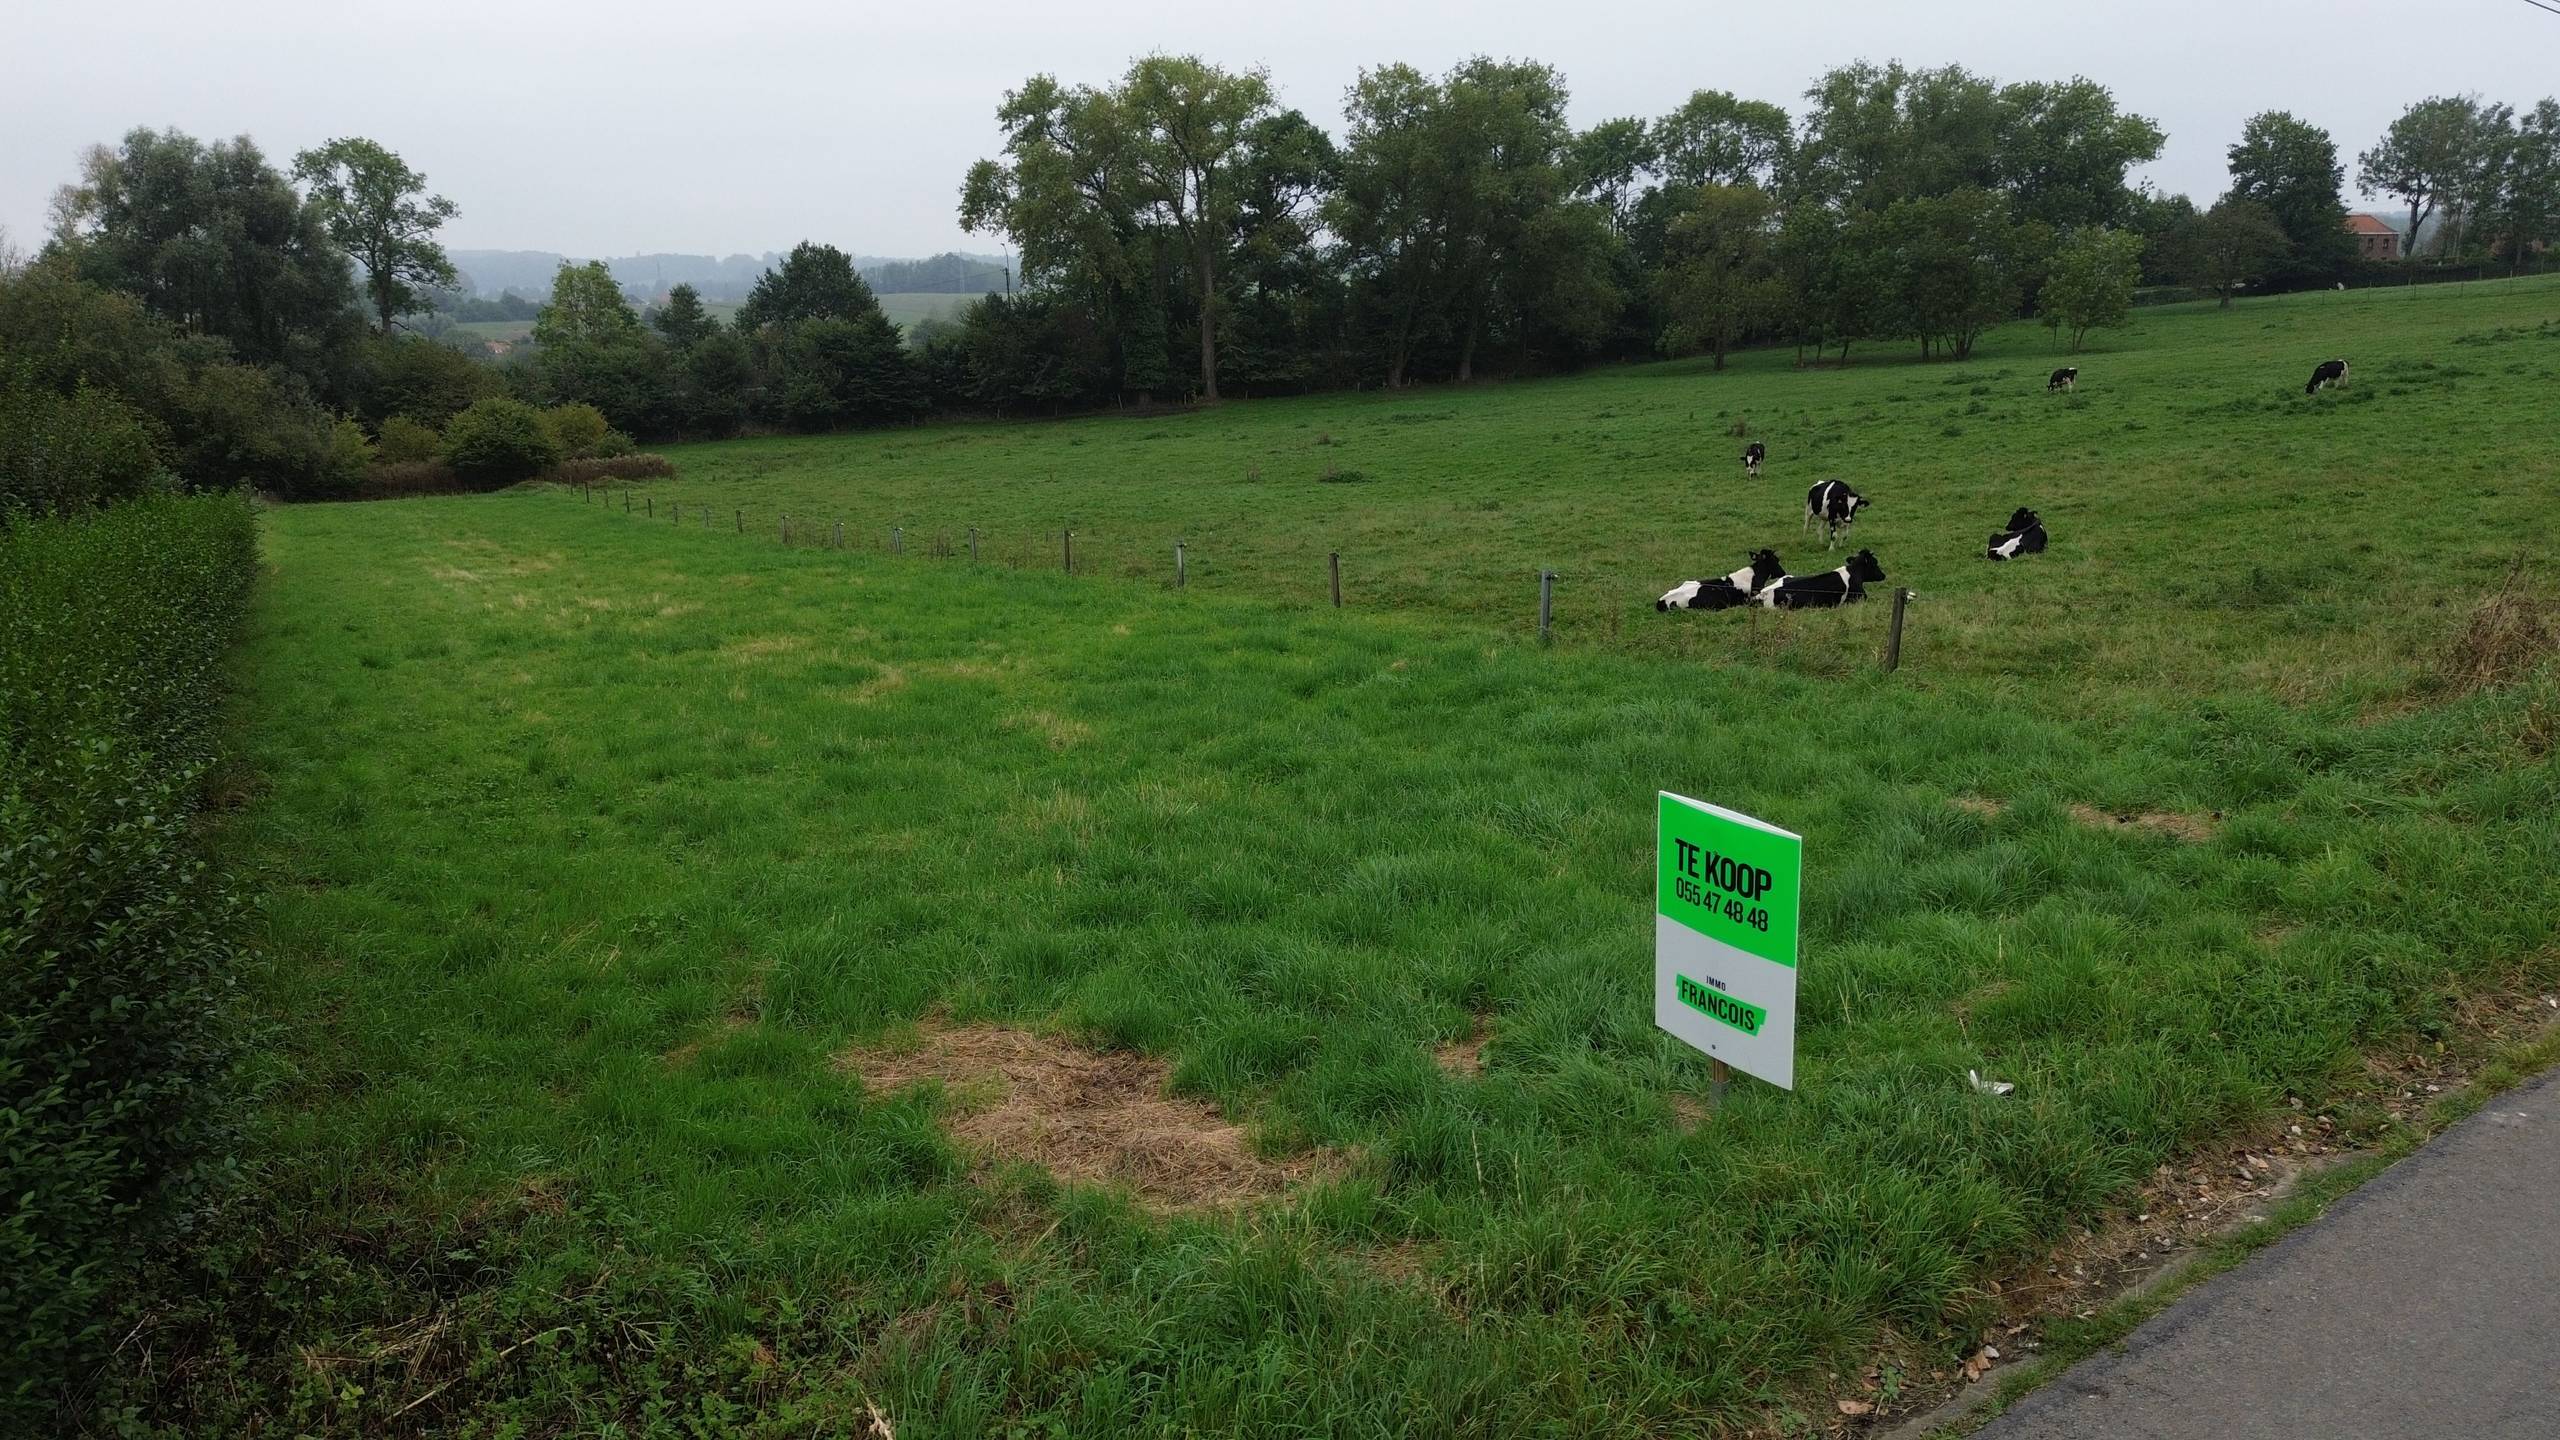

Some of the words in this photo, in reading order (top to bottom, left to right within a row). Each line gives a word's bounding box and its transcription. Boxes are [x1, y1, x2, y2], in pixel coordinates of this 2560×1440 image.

[1675, 838, 1699, 878] TE
[1705, 851, 1772, 901] KOOP
[1676, 877, 1700, 906] 055
[1703, 890, 1721, 913] 47
[1724, 899, 1743, 923] 48
[1747, 908, 1768, 932] 48
[1682, 980, 1754, 1031] FRANCOIS
[1706, 976, 1726, 991] IMMO
